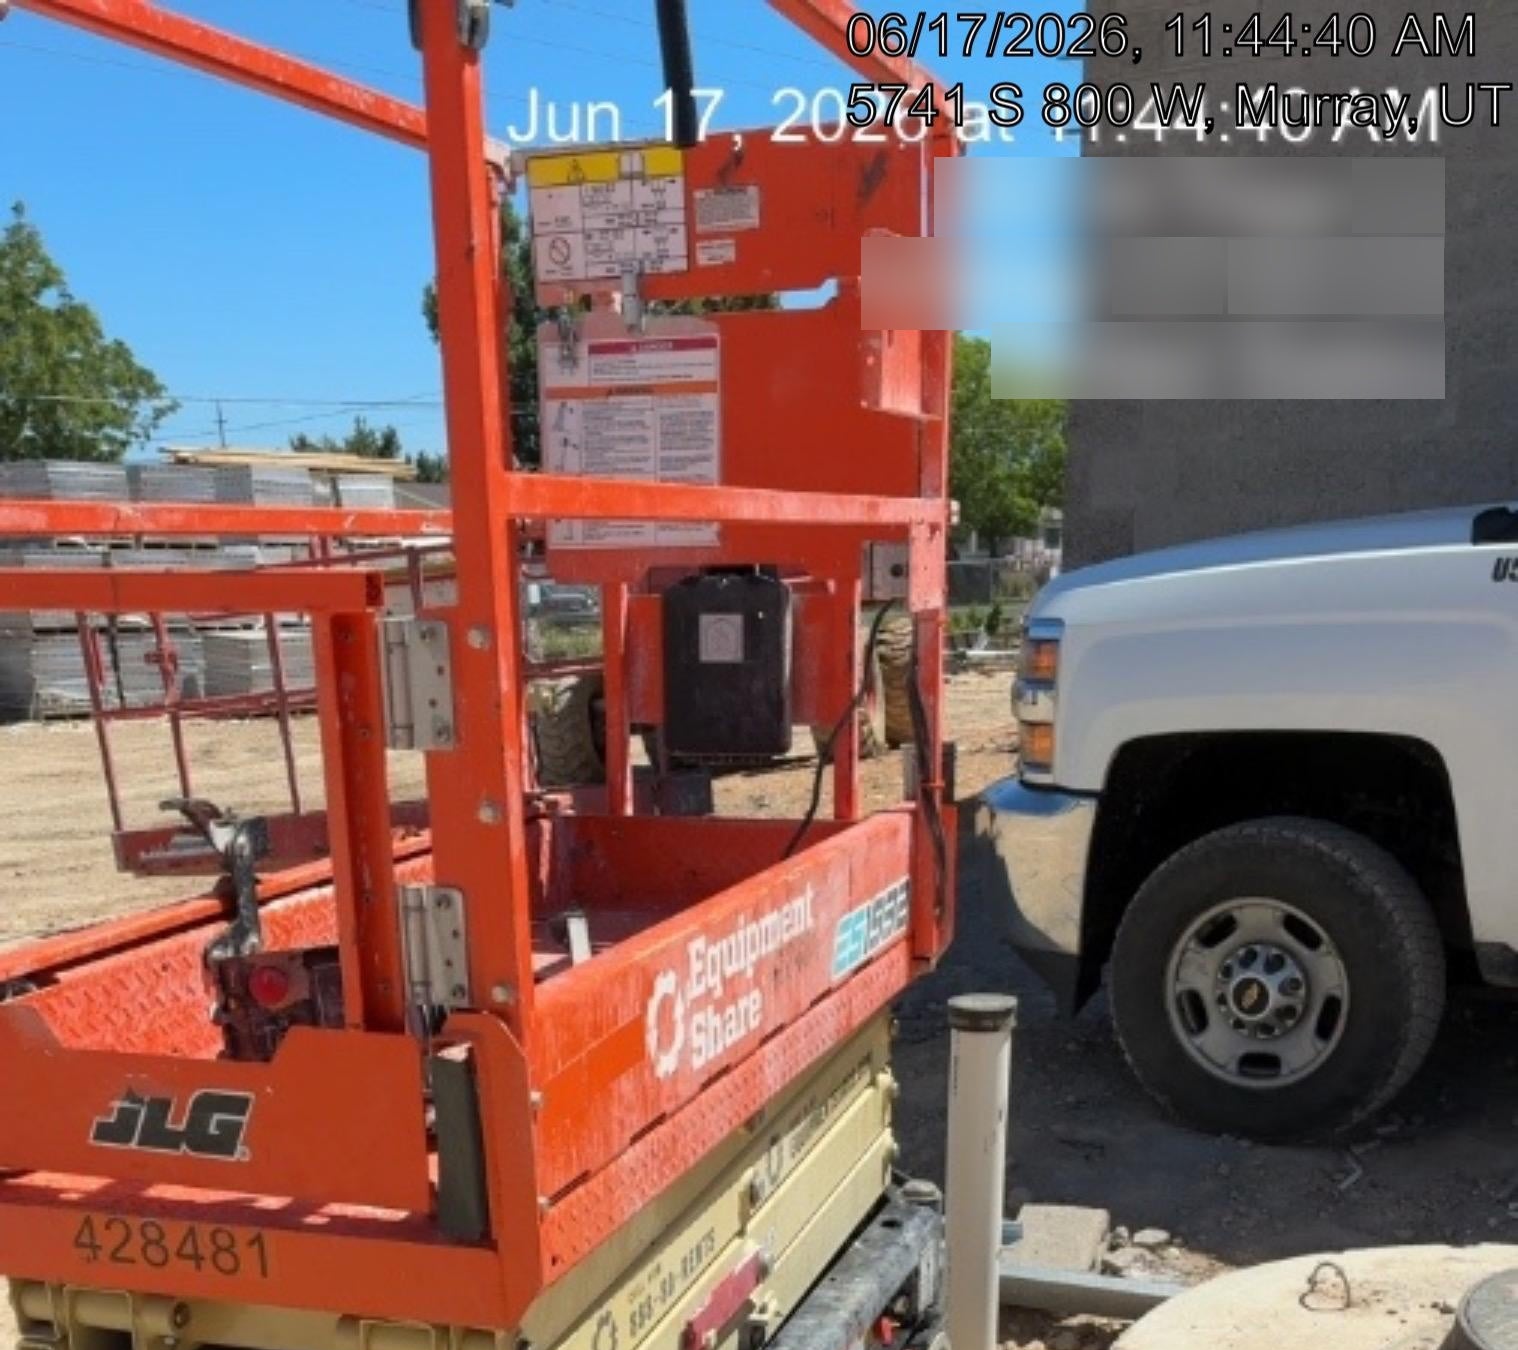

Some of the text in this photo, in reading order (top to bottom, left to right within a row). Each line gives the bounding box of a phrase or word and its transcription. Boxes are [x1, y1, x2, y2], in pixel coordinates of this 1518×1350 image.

[686, 882, 815, 1000] Equipment
[691, 987, 763, 1070] Share
[88, 1087, 256, 1162] JLG
[74, 1213, 269, 1280] 428481
